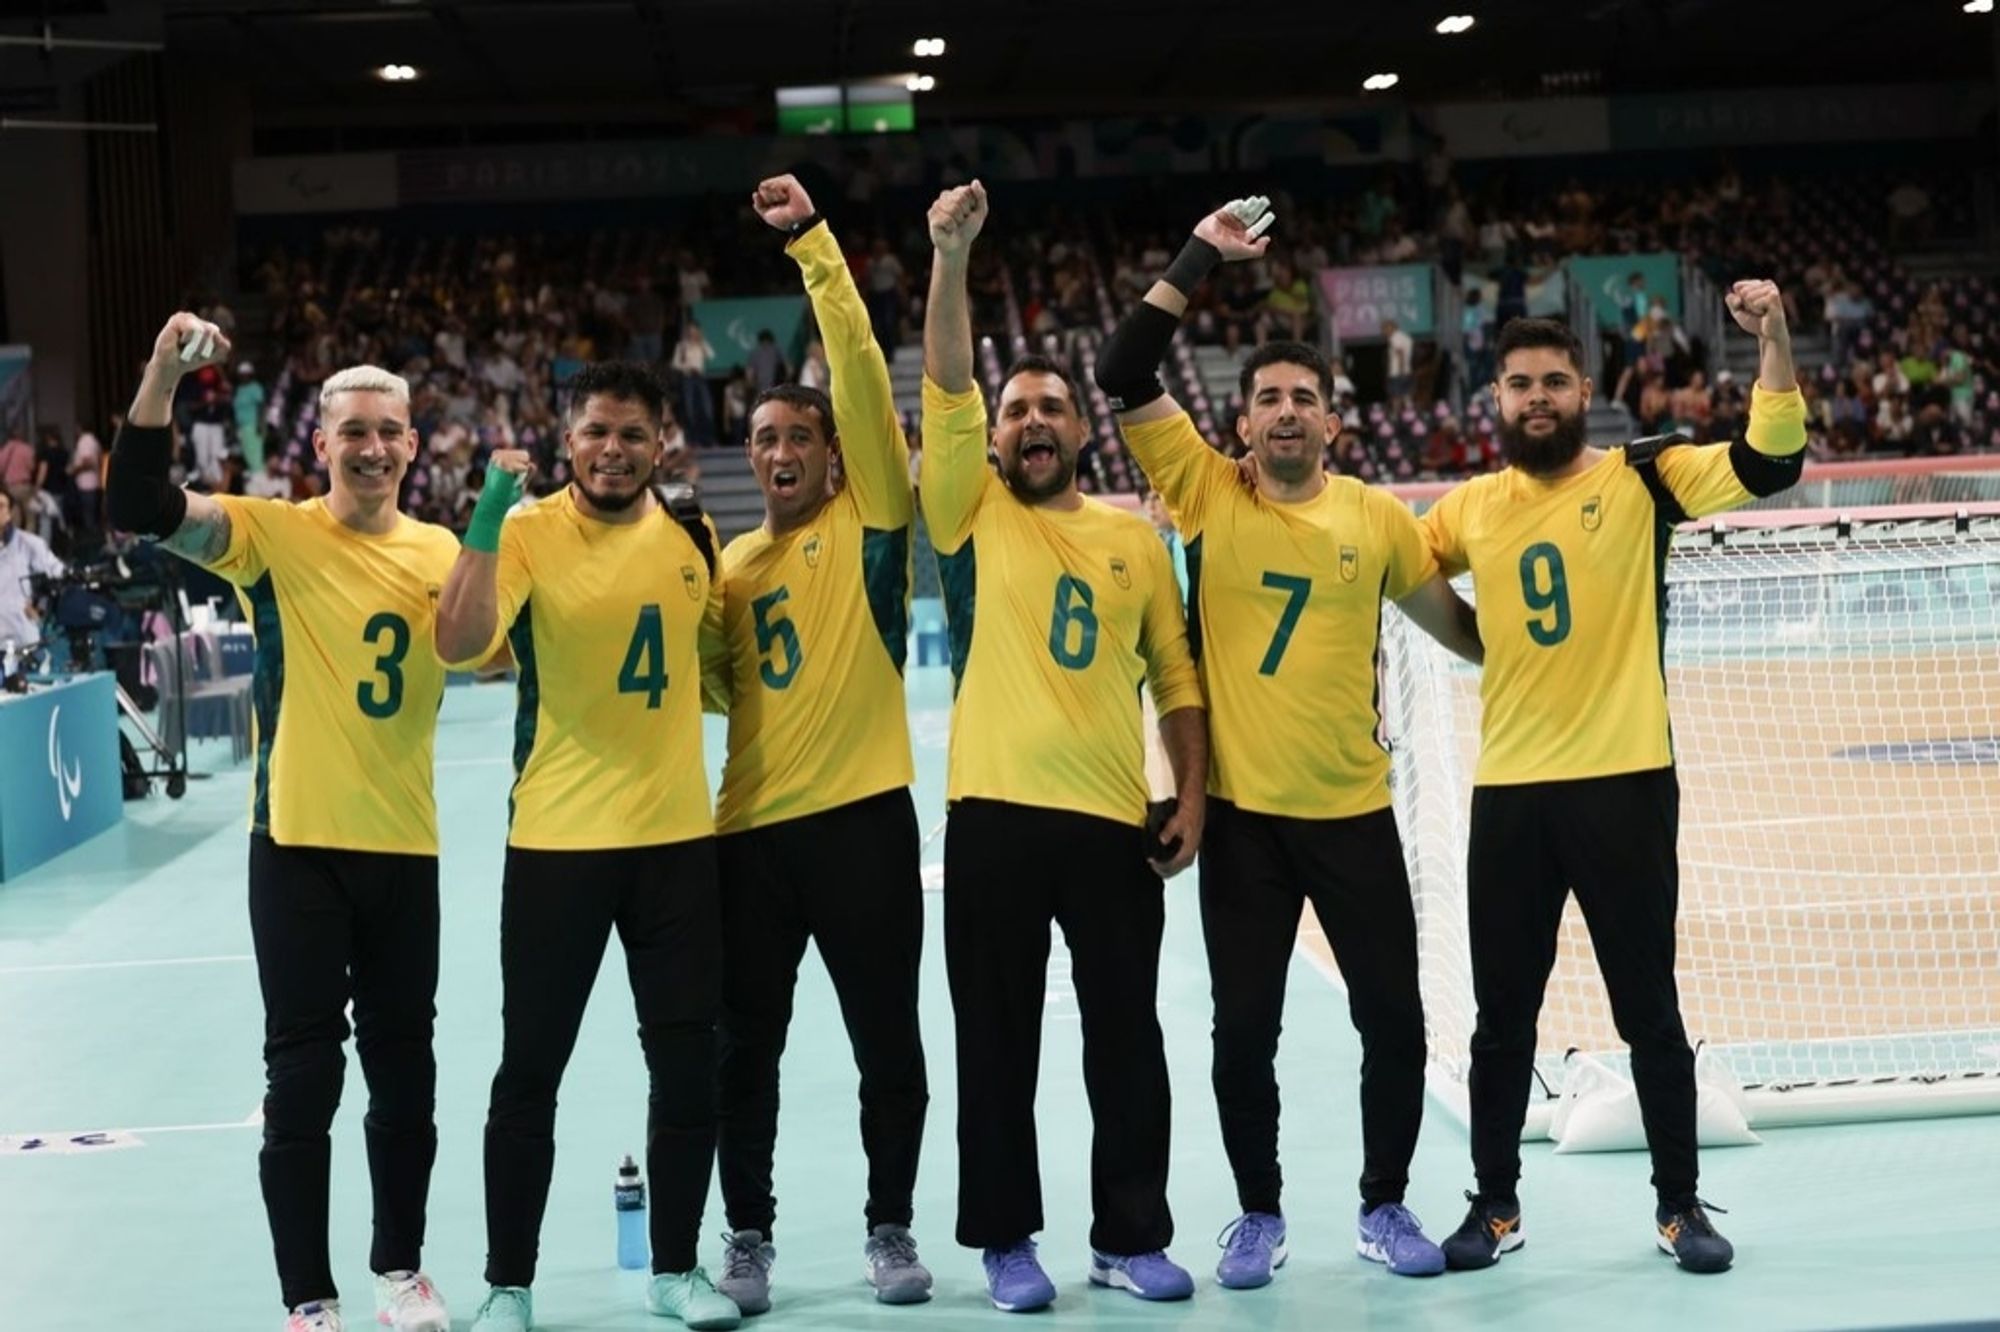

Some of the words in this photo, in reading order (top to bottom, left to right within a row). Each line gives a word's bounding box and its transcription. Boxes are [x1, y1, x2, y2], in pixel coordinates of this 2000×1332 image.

[447, 160, 568, 190] PARIS
[588, 155, 698, 183] 2024
[1335, 276, 1415, 303] PARIS
[751, 586, 802, 690] 5
[1049, 573, 1099, 670] 6
[1260, 571, 1312, 676] 7
[1520, 542, 1571, 647] 9
[357, 612, 411, 719] 3
[618, 604, 669, 709] 4
